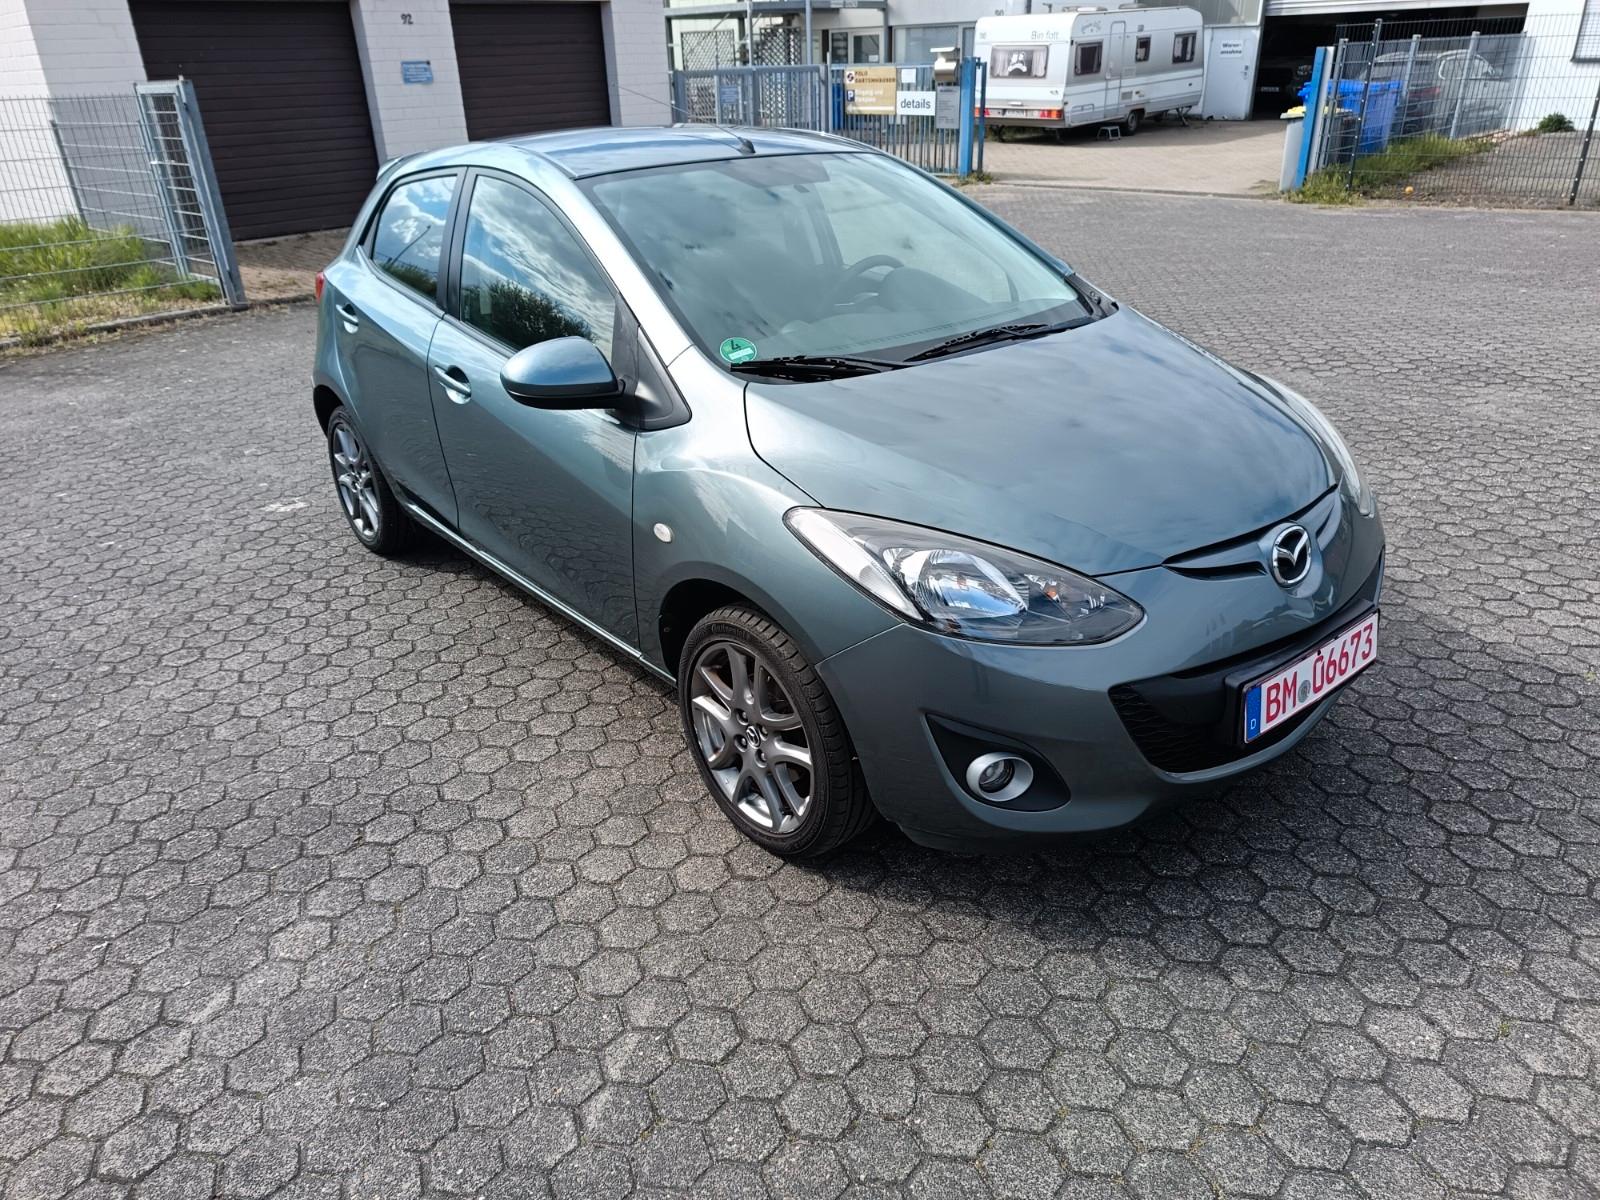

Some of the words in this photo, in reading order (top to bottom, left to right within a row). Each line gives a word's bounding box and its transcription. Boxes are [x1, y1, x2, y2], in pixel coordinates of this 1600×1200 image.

[401, 13, 414, 25] 92
[900, 98, 931, 109] details
[1266, 671, 1297, 724] BM
[1312, 622, 1373, 694] 06673
[1250, 718, 1256, 730] D
